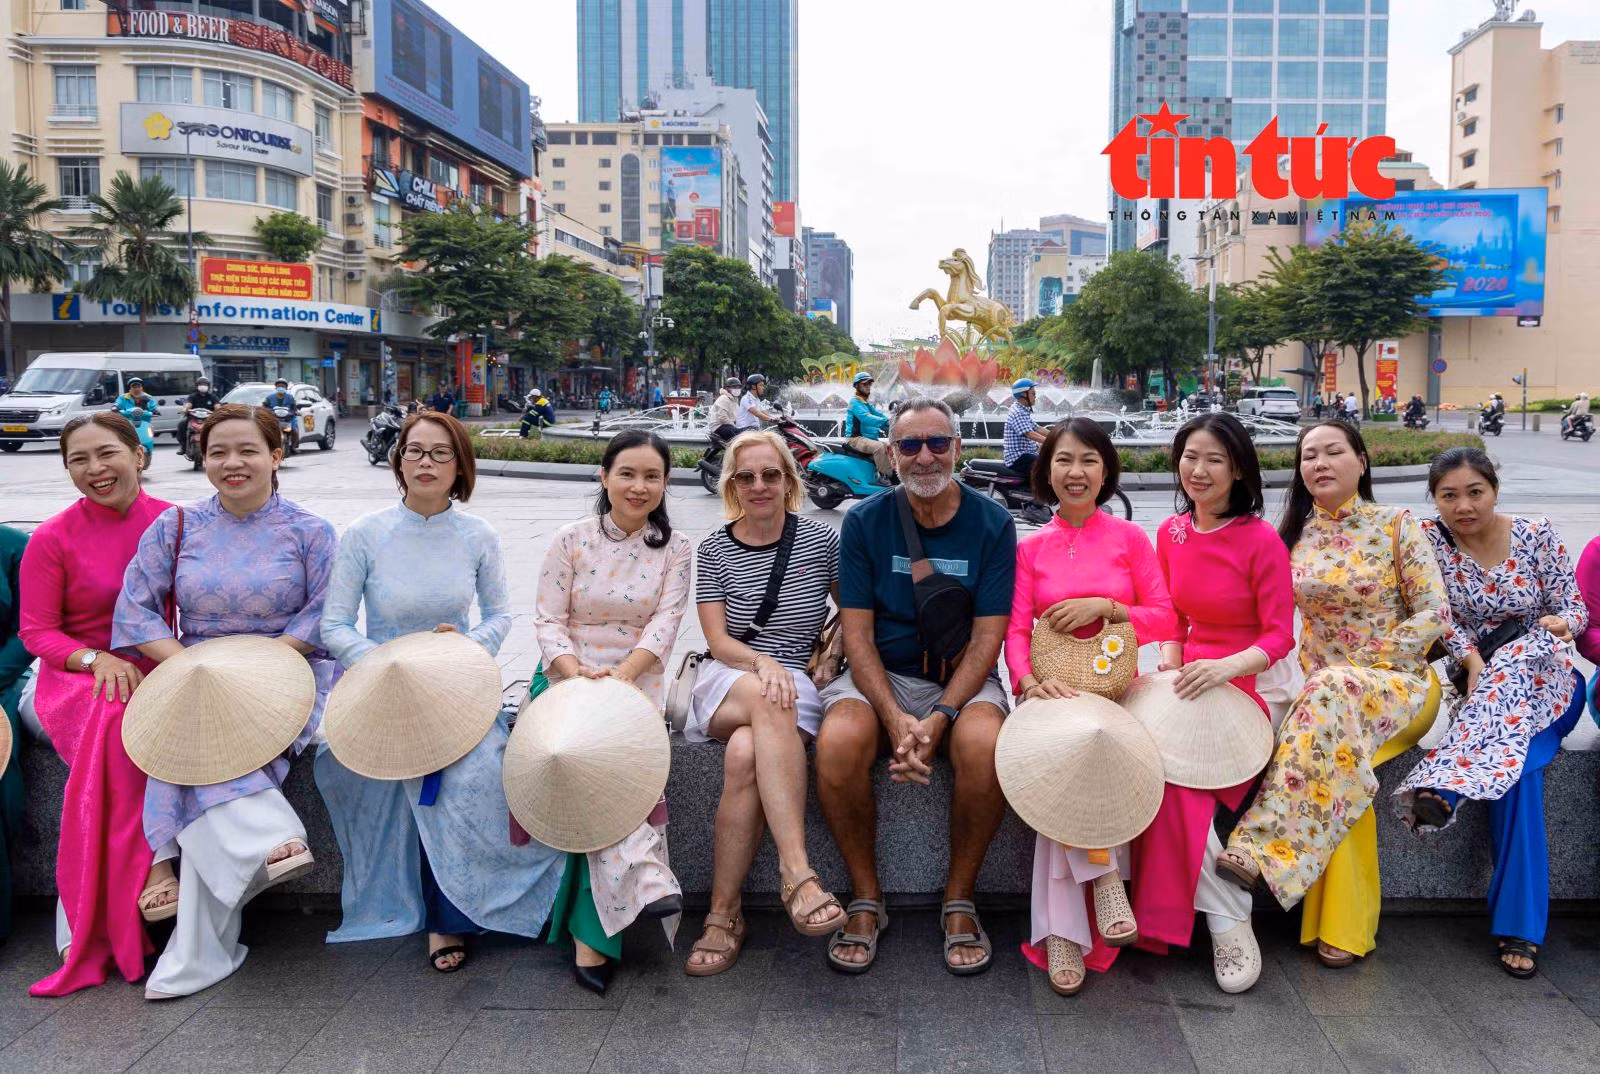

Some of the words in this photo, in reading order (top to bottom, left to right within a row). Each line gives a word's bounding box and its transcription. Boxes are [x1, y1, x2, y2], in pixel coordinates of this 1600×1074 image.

[129, 11, 169, 36] FOOD
[173, 16, 183, 34] &
[187, 14, 230, 43] BEER
[234, 20, 297, 61] SKY
[305, 46, 354, 88] ZONE
[216, 140, 240, 150] Savour
[98, 299, 184, 316] Touist
[190, 302, 319, 322] nformation
[325, 308, 365, 326] Center
[934, 561, 961, 571] NIQUE
